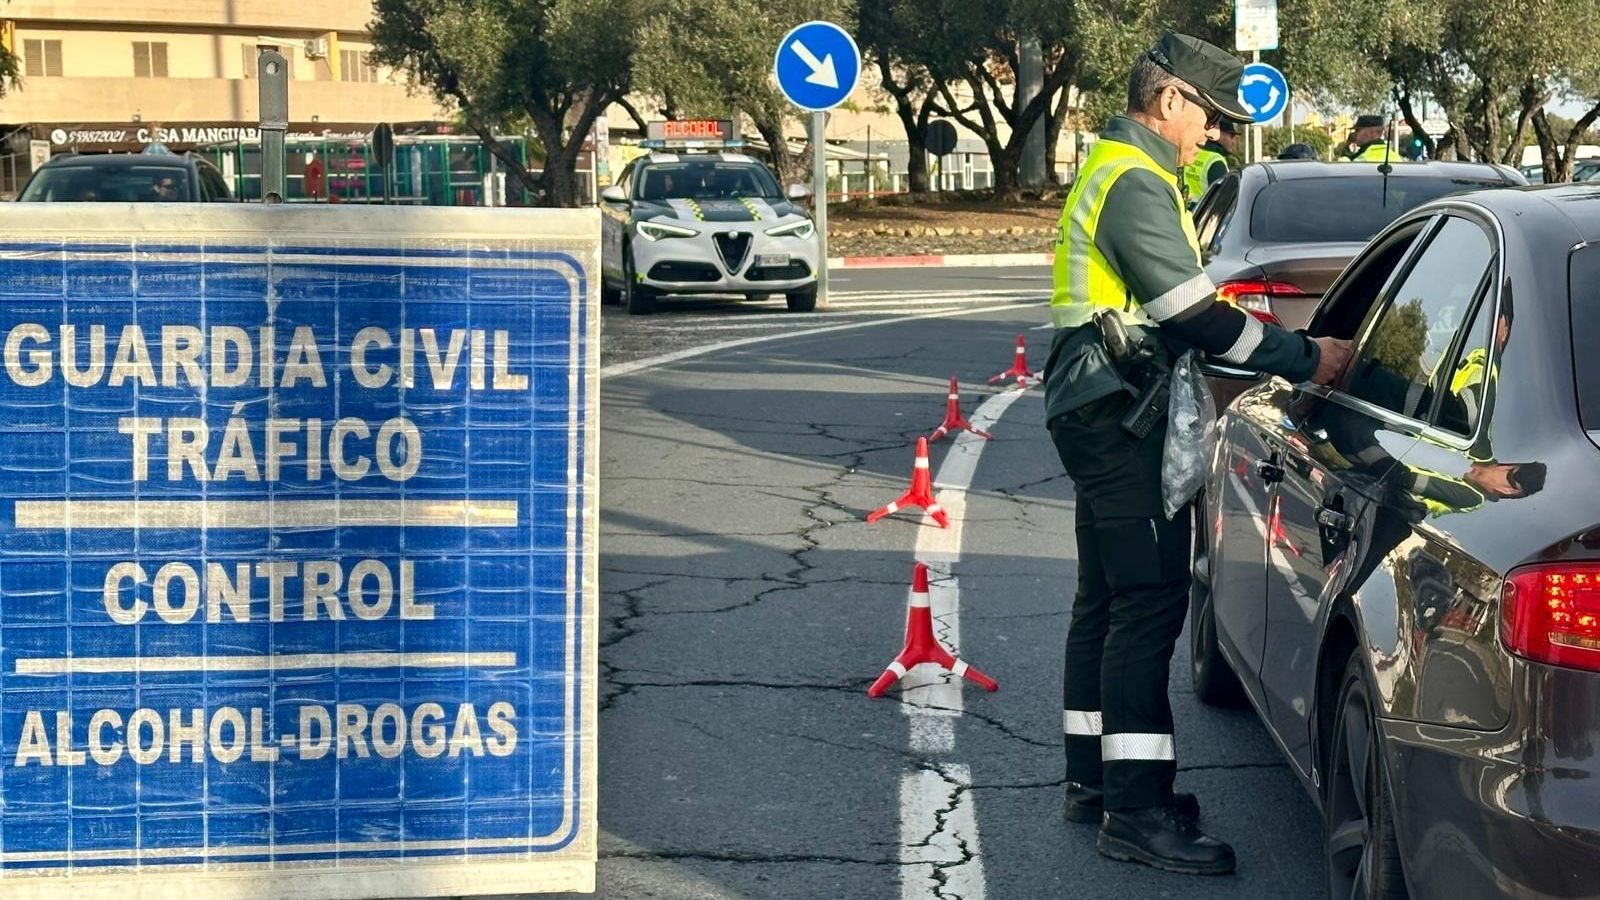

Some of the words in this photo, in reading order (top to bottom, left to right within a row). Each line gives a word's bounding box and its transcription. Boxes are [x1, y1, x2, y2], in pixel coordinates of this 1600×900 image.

[137, 128, 179, 143] CSA
[664, 121, 724, 136] ALCOHOL
[4, 322, 327, 389] GUARDIA
[350, 327, 529, 391] CIVIL
[118, 402, 422, 482] TRÁFICO
[103, 559, 435, 625] CONTROL
[14, 701, 518, 768] ALCOHOL-DROGAS
